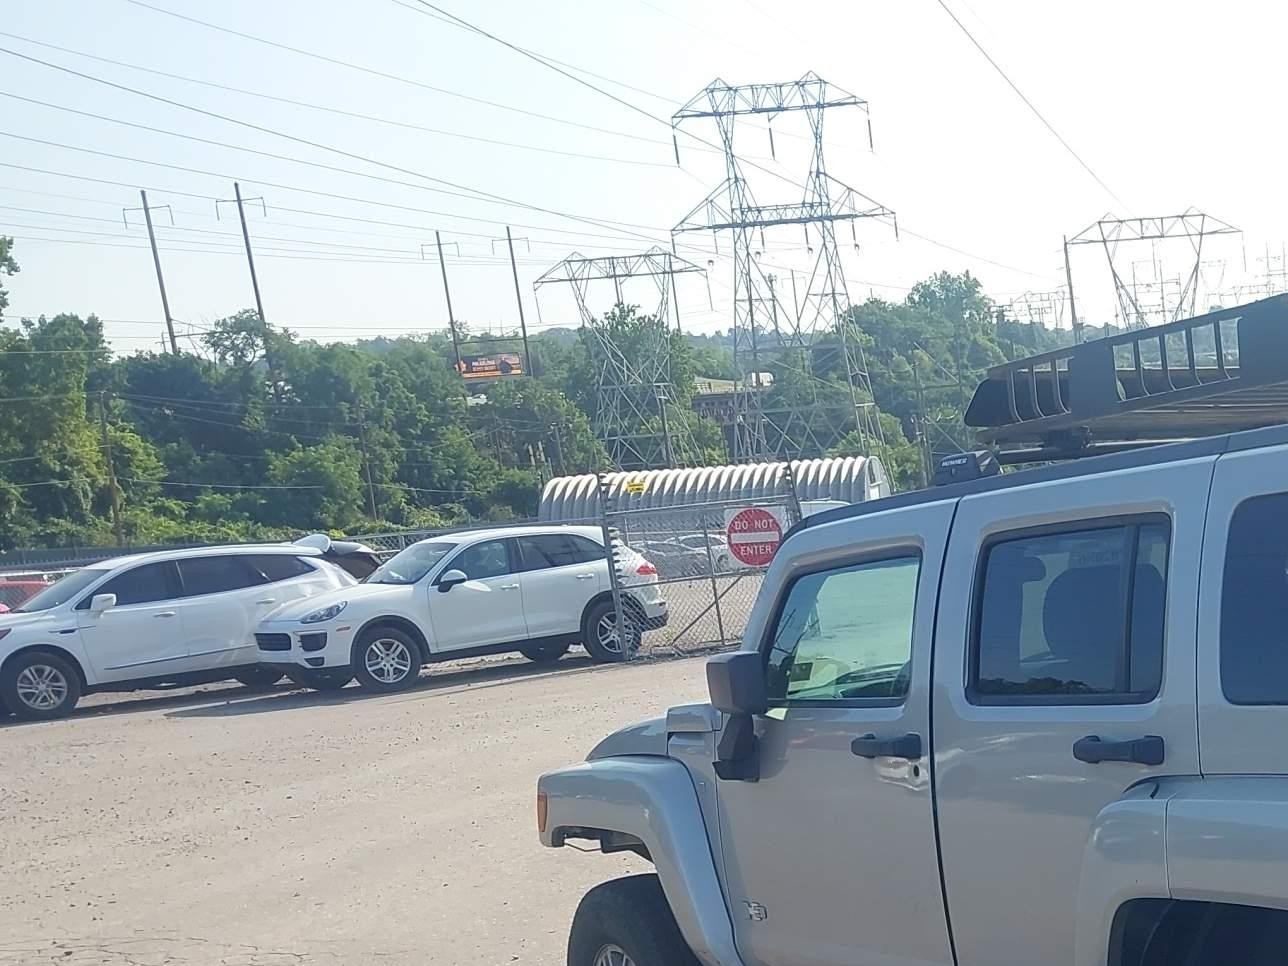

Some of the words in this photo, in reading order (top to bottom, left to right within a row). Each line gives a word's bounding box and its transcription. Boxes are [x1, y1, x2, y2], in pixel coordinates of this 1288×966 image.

[734, 521, 748, 530] DO
[754, 519, 774, 529] NOT
[740, 545, 773, 555] ENTER
